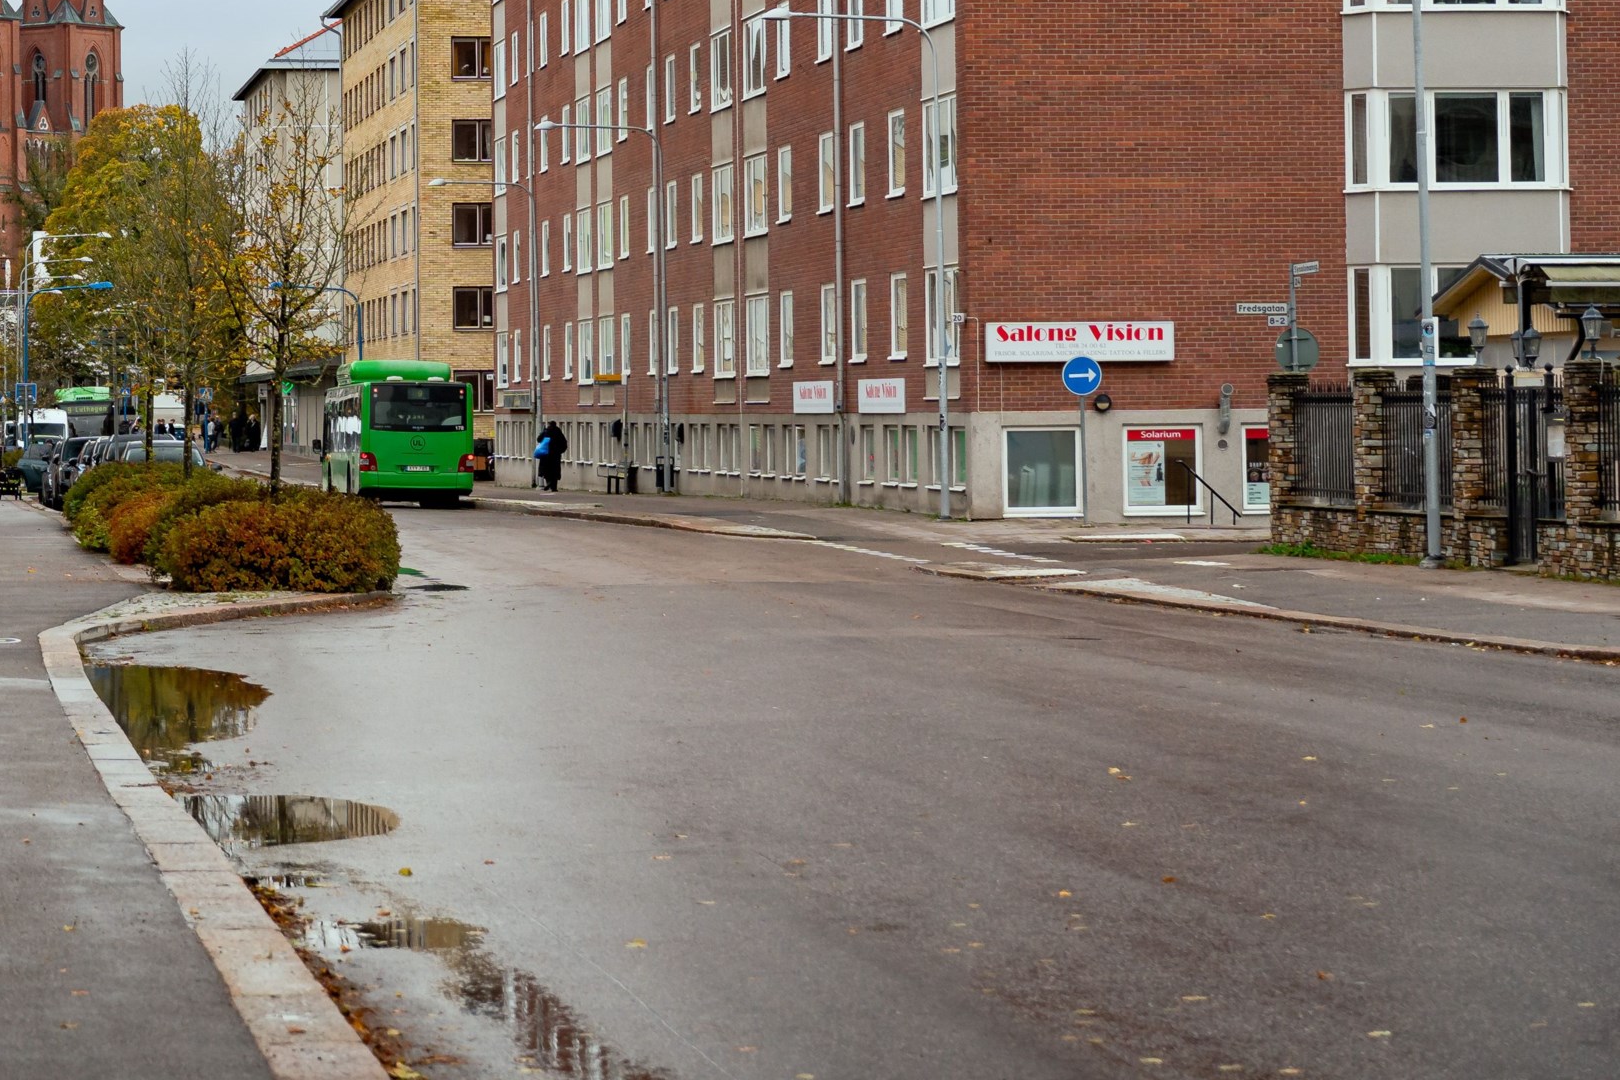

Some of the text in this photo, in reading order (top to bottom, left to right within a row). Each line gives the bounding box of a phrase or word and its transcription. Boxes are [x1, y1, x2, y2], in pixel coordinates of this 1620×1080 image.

[1238, 305, 1285, 313] Fredsgatan
[953, 314, 962, 322] 20
[1269, 317, 1286, 325] 8-2
[996, 323, 1164, 342] Salong Vision
[1140, 430, 1181, 439] Solarium
